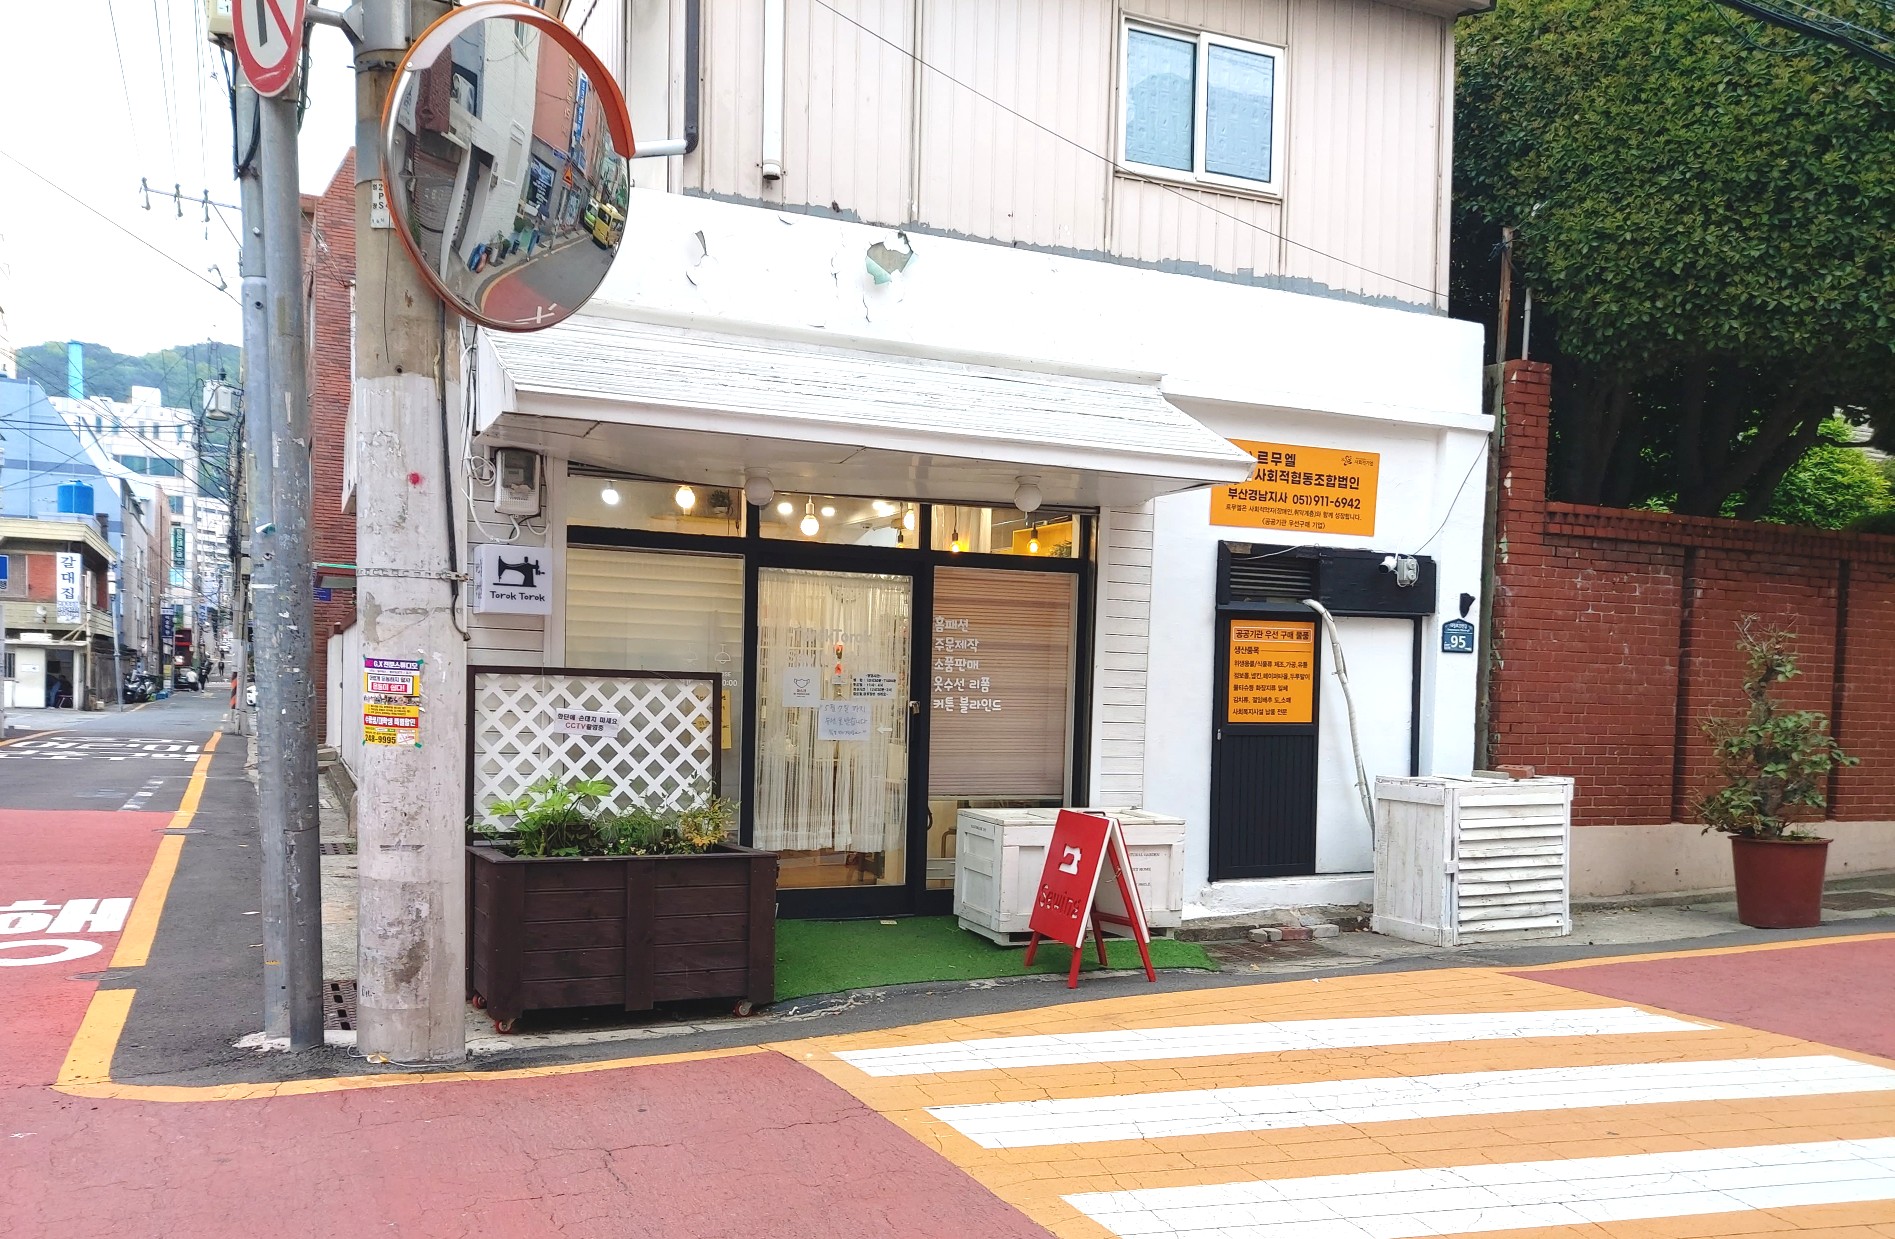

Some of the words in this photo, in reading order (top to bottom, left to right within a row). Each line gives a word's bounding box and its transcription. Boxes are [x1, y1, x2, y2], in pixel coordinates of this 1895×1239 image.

[1255, 468, 1360, 490] 사회적협동조합법인
[1228, 488, 1287, 503] 부산경남지사
[1292, 494, 1361, 510] 051)911-6942
[61, 556, 76, 599] 갈대집
[489, 591, 517, 601] Torok
[518, 592, 546, 602] Torok
[934, 616, 969, 633] 홈패션
[1236, 629, 1263, 639] 공공기관
[1265, 631, 1279, 639] 우선
[1281, 631, 1294, 639] 구매
[1450, 635, 1466, 649] 95
[934, 636, 980, 653] 주문제작
[1234, 646, 1259, 654] 생산품목
[934, 656, 979, 673] 소품판매
[933, 676, 965, 692] 옷수선
[969, 676, 990, 693] 리폼
[933, 696, 954, 712] 커튼
[960, 696, 1002, 714] 블라인드
[557, 712, 575, 721] 화단에
[578, 713, 597, 723] 손대지
[599, 715, 618, 724] 마세요
[1039, 883, 1082, 919] Sewing
